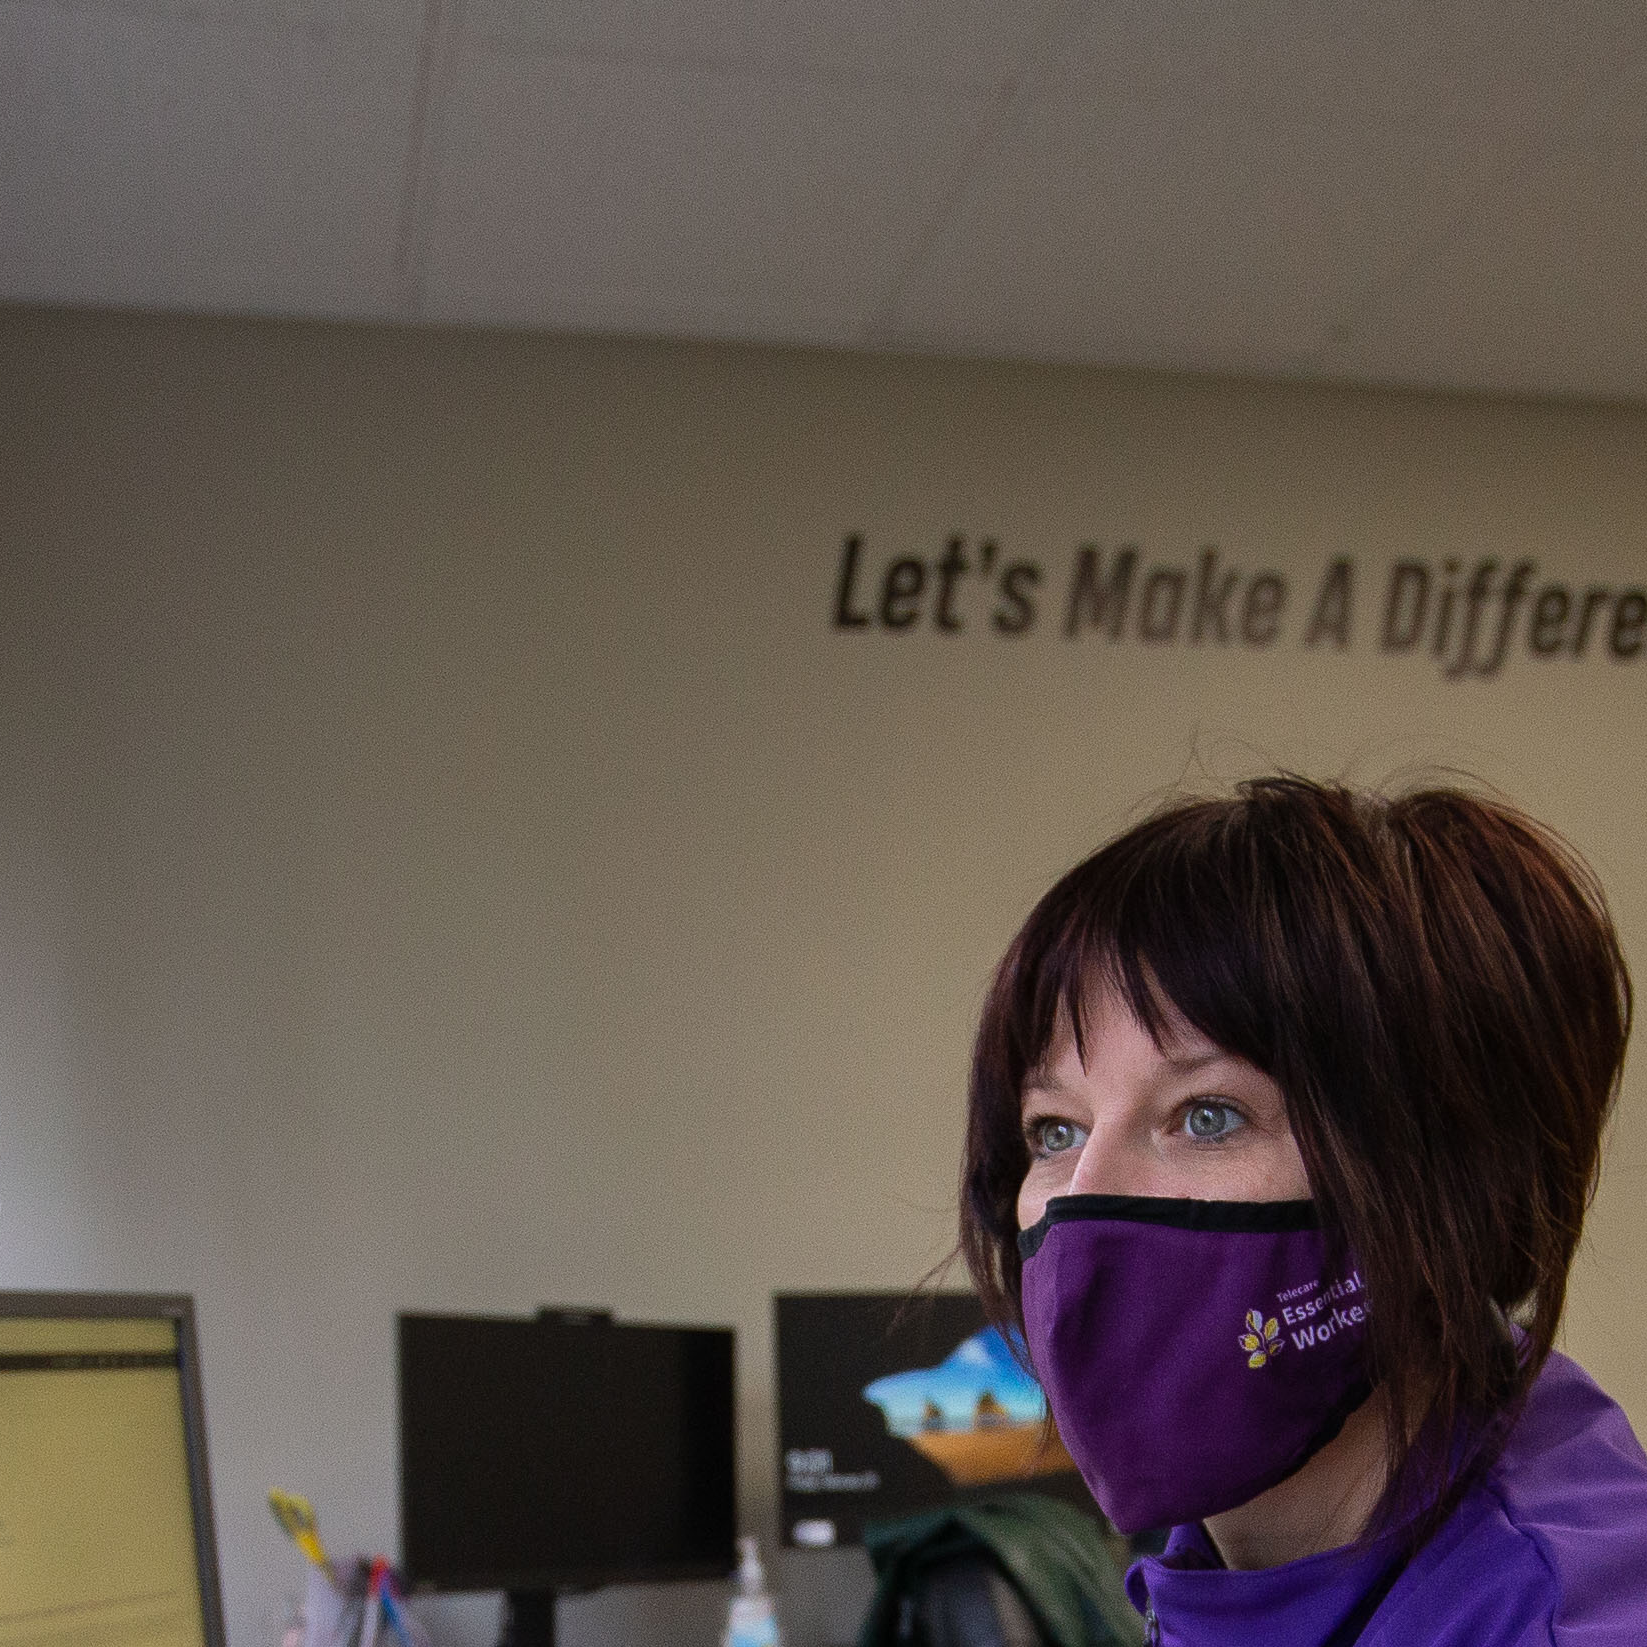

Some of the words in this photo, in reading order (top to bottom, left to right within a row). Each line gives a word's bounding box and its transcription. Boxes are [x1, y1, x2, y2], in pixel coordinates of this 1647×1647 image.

[832, 531, 1041, 637] Let's
[1061, 543, 1289, 650] Make
[1303, 555, 1357, 655] A
[1276, 1279, 1319, 1304] Telecare
[1281, 1271, 1365, 1327] Essential
